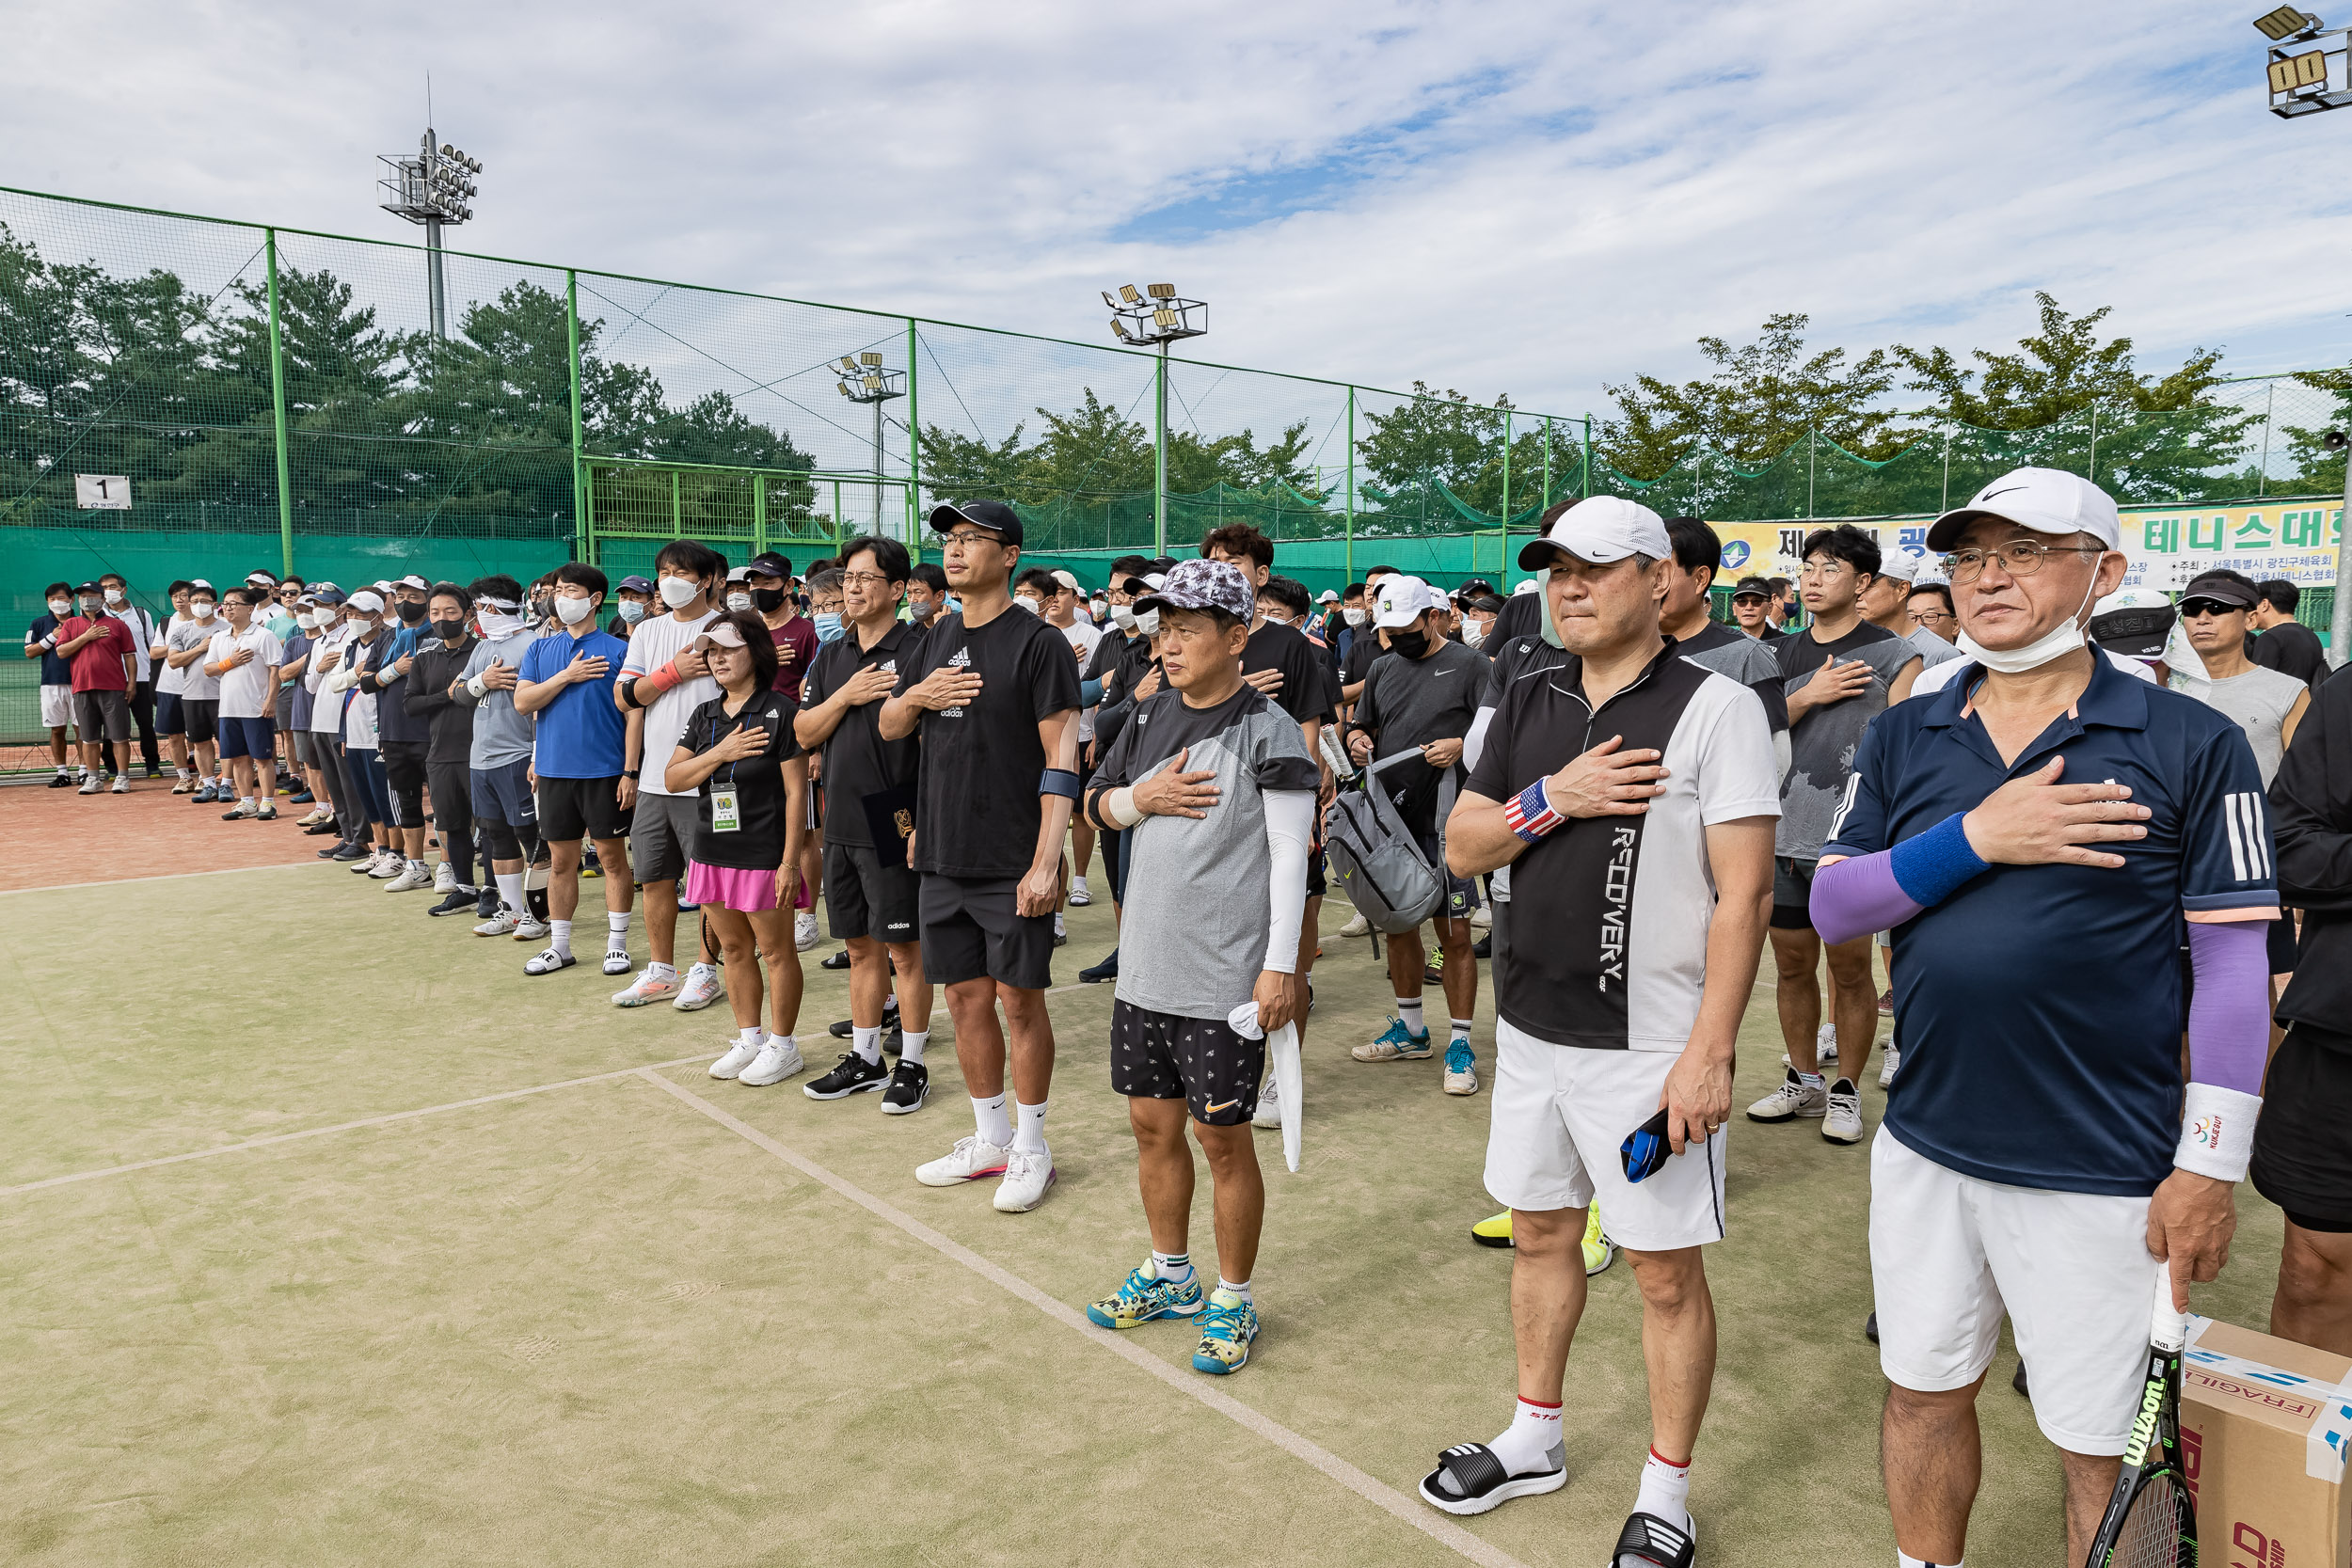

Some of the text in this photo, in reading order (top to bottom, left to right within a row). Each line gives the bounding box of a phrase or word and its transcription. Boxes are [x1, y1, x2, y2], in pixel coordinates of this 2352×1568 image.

[97, 480, 108, 499] 1
[2180, 561, 2200, 571] 주최
[2266, 554, 2332, 569] 광진구체육회
[948, 658, 971, 667] adidas
[605, 951, 629, 960] NIKE
[1530, 1412, 1562, 1421] star
